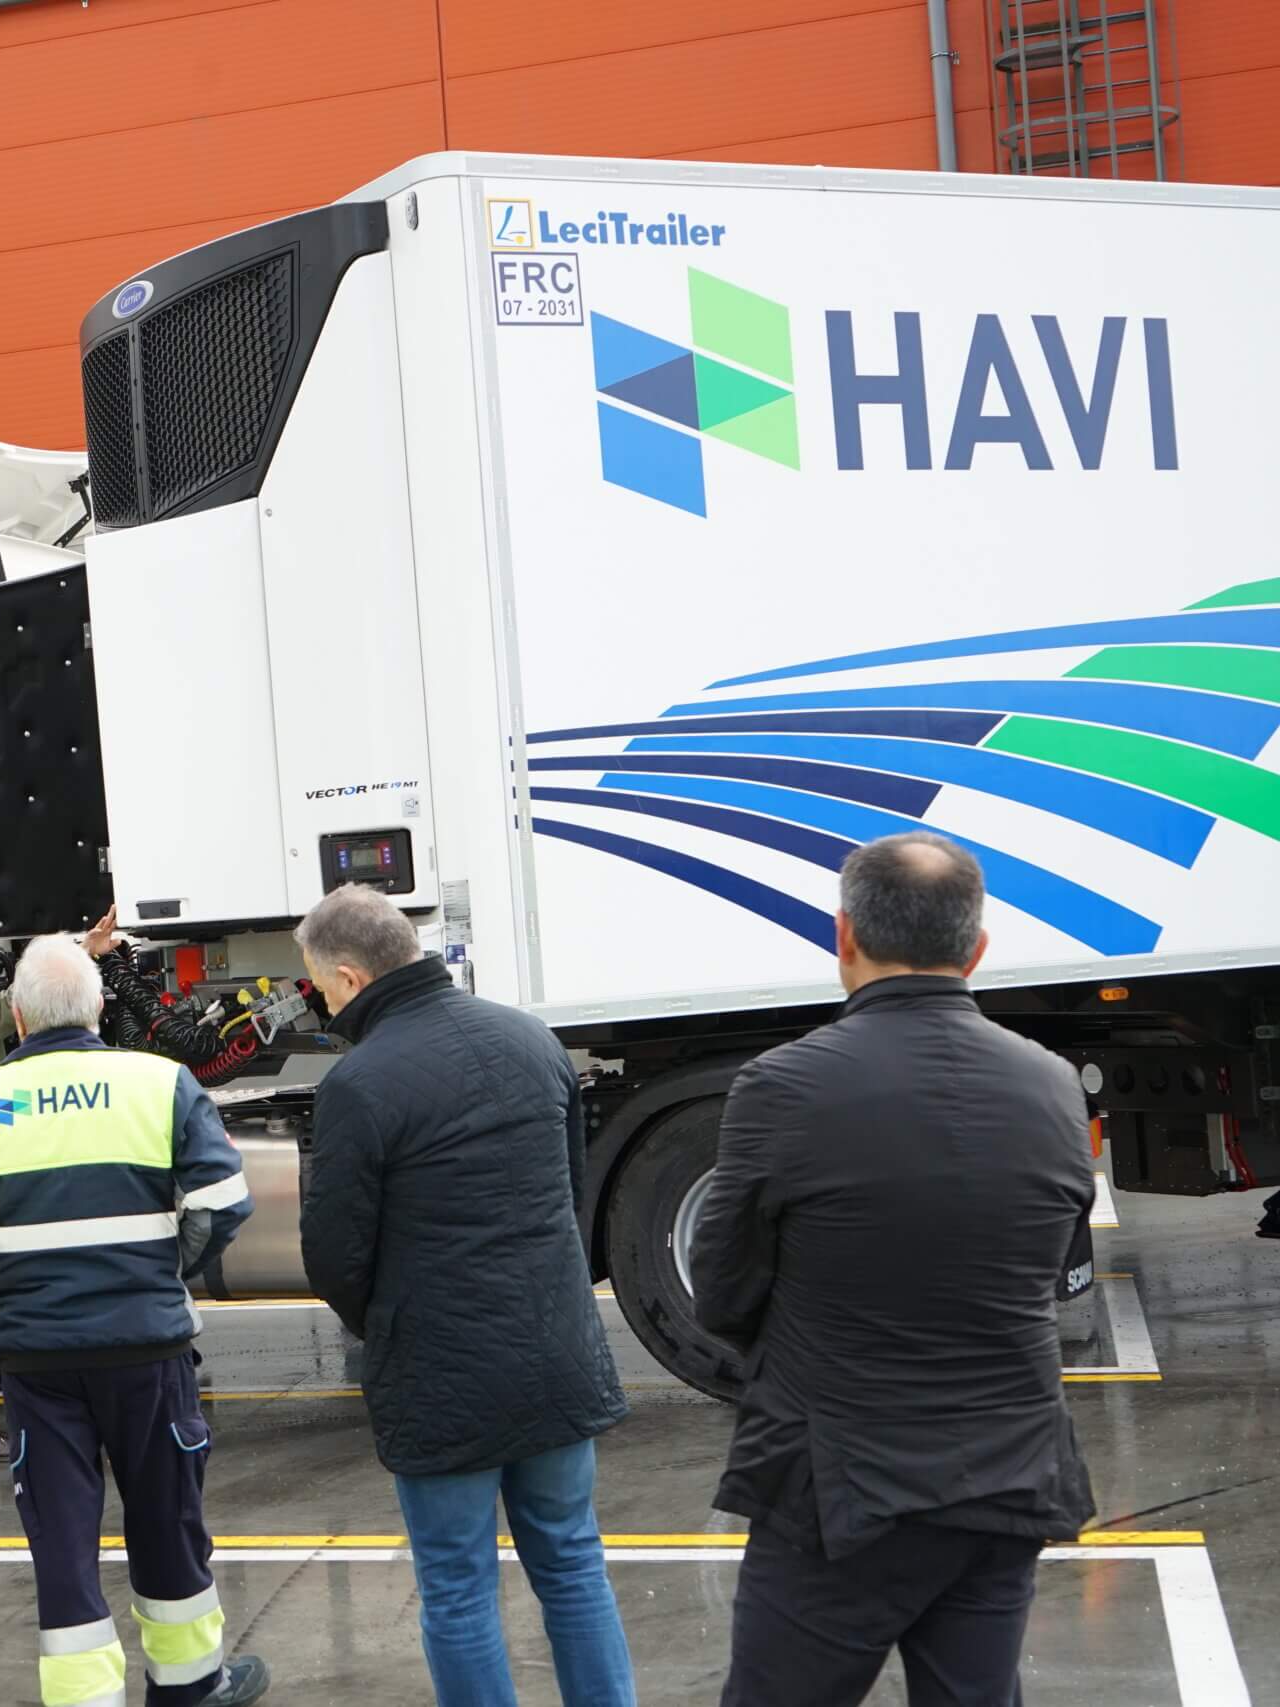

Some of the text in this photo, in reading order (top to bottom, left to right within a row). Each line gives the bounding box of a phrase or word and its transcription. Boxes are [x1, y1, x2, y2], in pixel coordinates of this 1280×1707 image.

[539, 211, 725, 246] LeciTrailer
[498, 262, 575, 294] FRC
[120, 290, 142, 309] Carrier
[503, 300, 522, 316] 07
[538, 300, 576, 316] 2031
[825, 310, 1179, 470] HAVI
[305, 785, 367, 800] VECTOR
[371, 782, 388, 791] HE
[38, 1082, 110, 1114] HAVI
